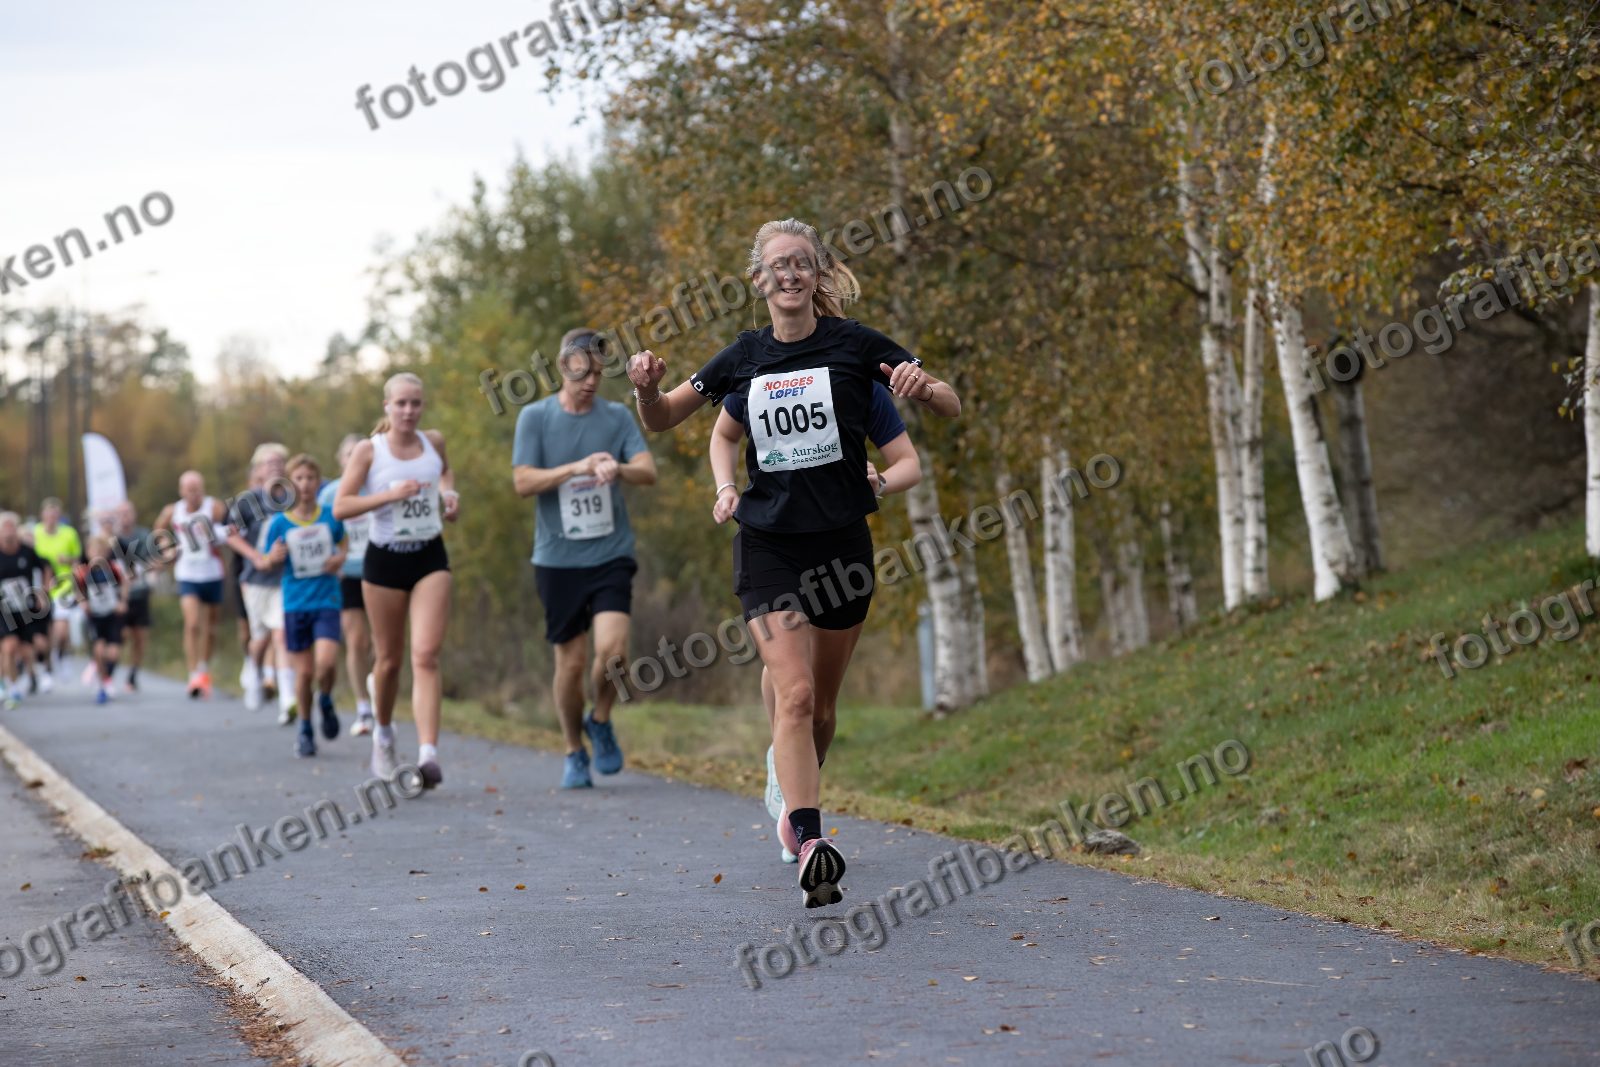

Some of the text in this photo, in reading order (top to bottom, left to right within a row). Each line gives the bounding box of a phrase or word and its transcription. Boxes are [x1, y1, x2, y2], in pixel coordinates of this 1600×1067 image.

[763, 376, 814, 391] NORGES
[769, 386, 807, 400] LØPET
[758, 401, 828, 437] 1005
[791, 442, 838, 458] Aurskog
[402, 499, 431, 518] 206
[570, 494, 603, 517] 319
